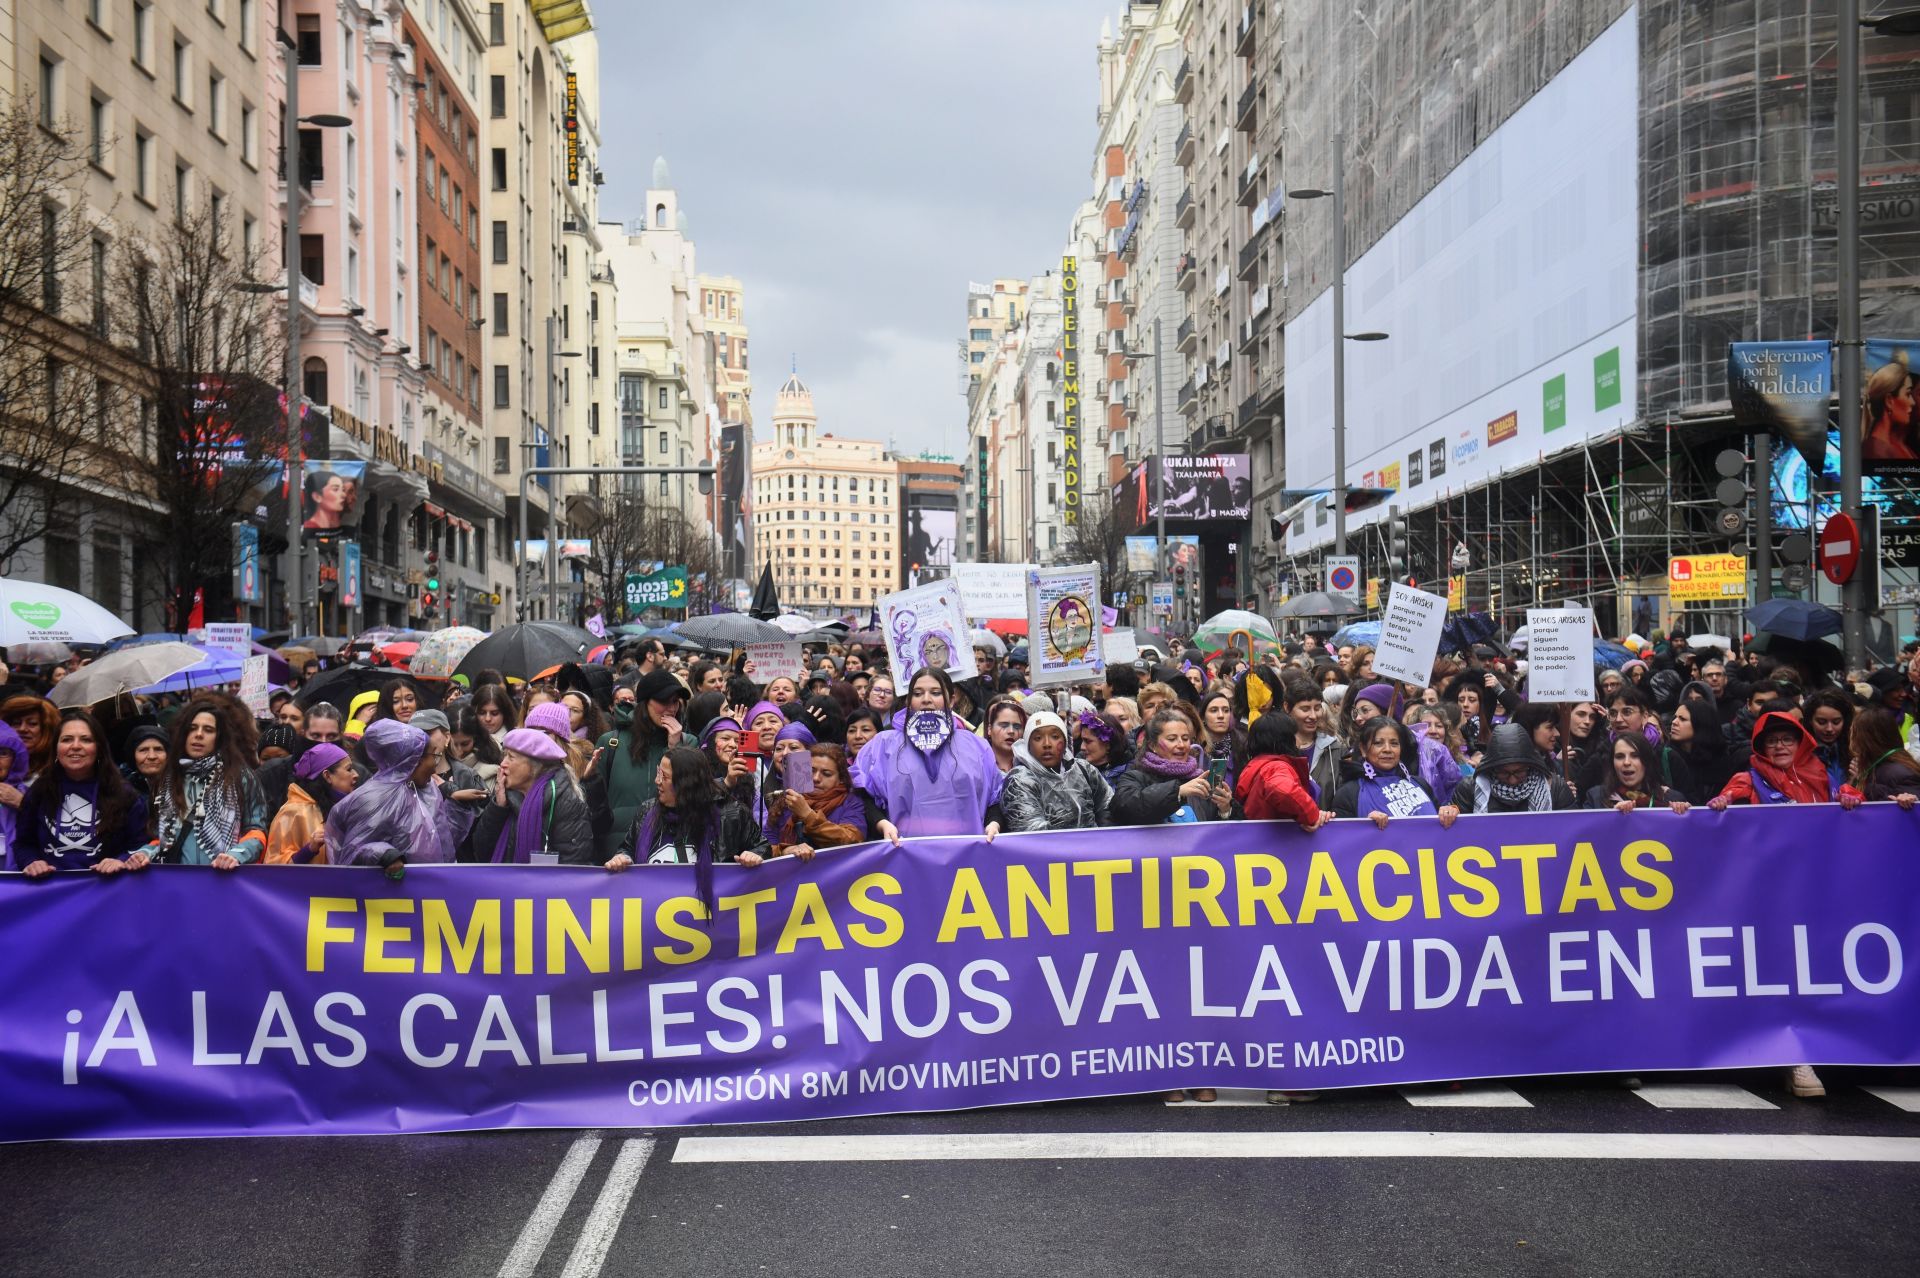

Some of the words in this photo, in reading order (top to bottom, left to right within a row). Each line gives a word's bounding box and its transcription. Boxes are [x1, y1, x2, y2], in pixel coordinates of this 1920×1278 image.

[567, 75, 577, 118] HOSTAL
[568, 131, 577, 180] BESAYA
[1063, 256, 1077, 349] HOTEL
[1738, 349, 1824, 364] Aceleremos
[1742, 367, 1763, 378] por
[1767, 364, 1777, 377] la
[1064, 361, 1079, 525] EMPERADOR
[1196, 457, 1237, 467] DANTZA
[1175, 471, 1222, 479] TXALAPARTA
[1219, 509, 1249, 517] MADRID
[1695, 558, 1745, 572] Lartec
[1680, 583, 1695, 591] 560
[1395, 592, 1409, 602] SOY
[1393, 604, 1416, 616] porque
[1391, 613, 1407, 623] pago
[1532, 616, 1556, 625] SOMOS
[1388, 622, 1411, 634] terapia
[1386, 631, 1399, 640] que
[1534, 636, 1558, 644] siguen
[1384, 640, 1415, 654] necesitas.
[1534, 645, 1569, 653] ocupando
[1546, 654, 1576, 662] espacios
[1545, 663, 1568, 671] poder.
[306, 873, 904, 976] FEMINISTAS
[938, 840, 1674, 943] ANTIRRACISTAS
[62, 990, 159, 1086] ¡A
[191, 990, 368, 1068] LAS
[399, 976, 786, 1069] CALLES!
[819, 958, 1013, 1046] NOS
[1036, 947, 1161, 1027] VA
[1189, 944, 1304, 1019] LA
[1321, 934, 1524, 1013] VIDA
[1549, 928, 1656, 1003] EN
[1686, 922, 1904, 998] ELLO
[627, 1067, 790, 1107] COMISIÓN
[801, 1070, 849, 1099] 8M
[858, 1051, 1062, 1095] MOVIMIENTO
[1070, 1040, 1236, 1078] FEMINISTA
[1244, 1042, 1285, 1069] DE
[1294, 1035, 1406, 1068] MADRID
